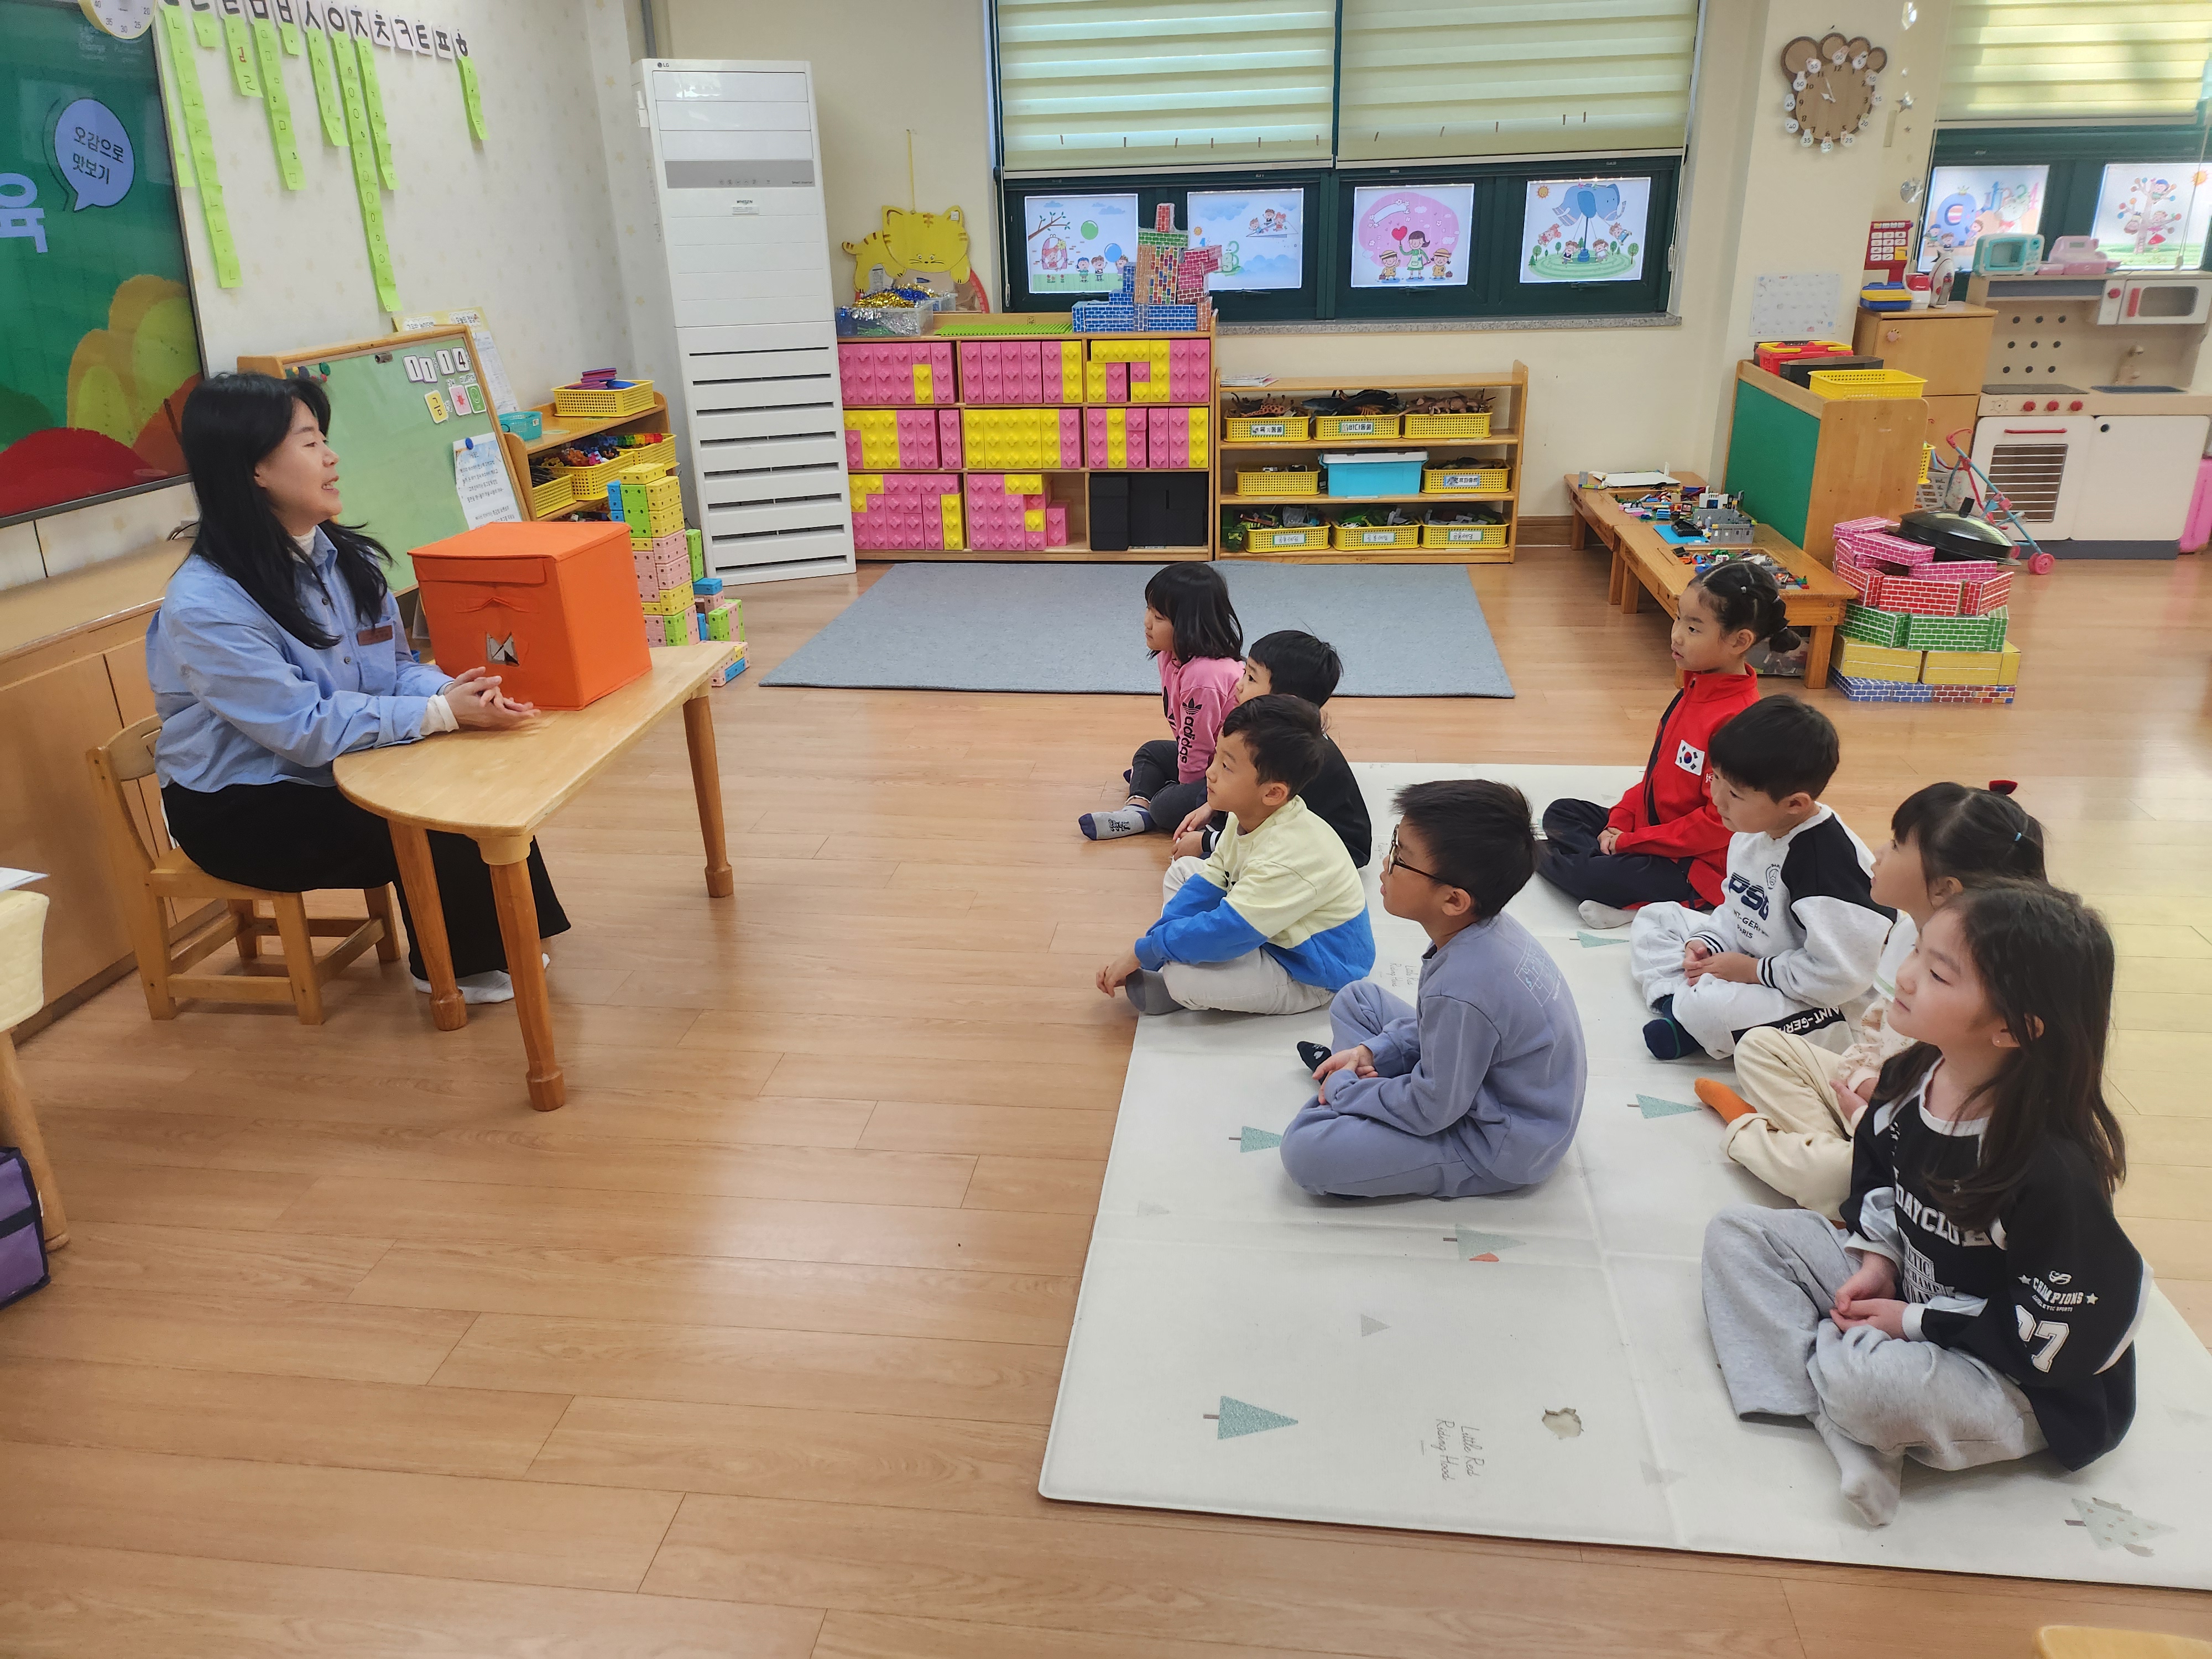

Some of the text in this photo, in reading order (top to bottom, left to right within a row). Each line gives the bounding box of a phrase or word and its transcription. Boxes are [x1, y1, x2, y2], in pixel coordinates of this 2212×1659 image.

[106, 18, 113, 26] 35
[251, 0, 269, 19] ㅁ
[278, 0, 294, 24] ㅂ
[306, 1, 321, 30] ㅅ
[328, 7, 345, 32] ㅇ
[351, 10, 368, 37] ㅈ
[375, 14, 390, 41] ㅊ
[395, 19, 414, 47] ㅋ
[416, 25, 430, 49] ㅌ
[436, 30, 451, 51] ㅍ
[456, 33, 468, 56] ㅎ
[74, 126, 124, 164] 오감으로
[73, 153, 110, 184] 맛보기
[442, 351, 466, 371] 14
[432, 397, 442, 416] 금
[1180, 716, 1196, 764] adidas
[1893, 1165, 1992, 1247] DAYCLUB
[2033, 1277, 2084, 1305] CHAMPIONS
[1431, 1418, 1459, 1481] Riding Hood
[1462, 1426, 1485, 1477] Little Red
